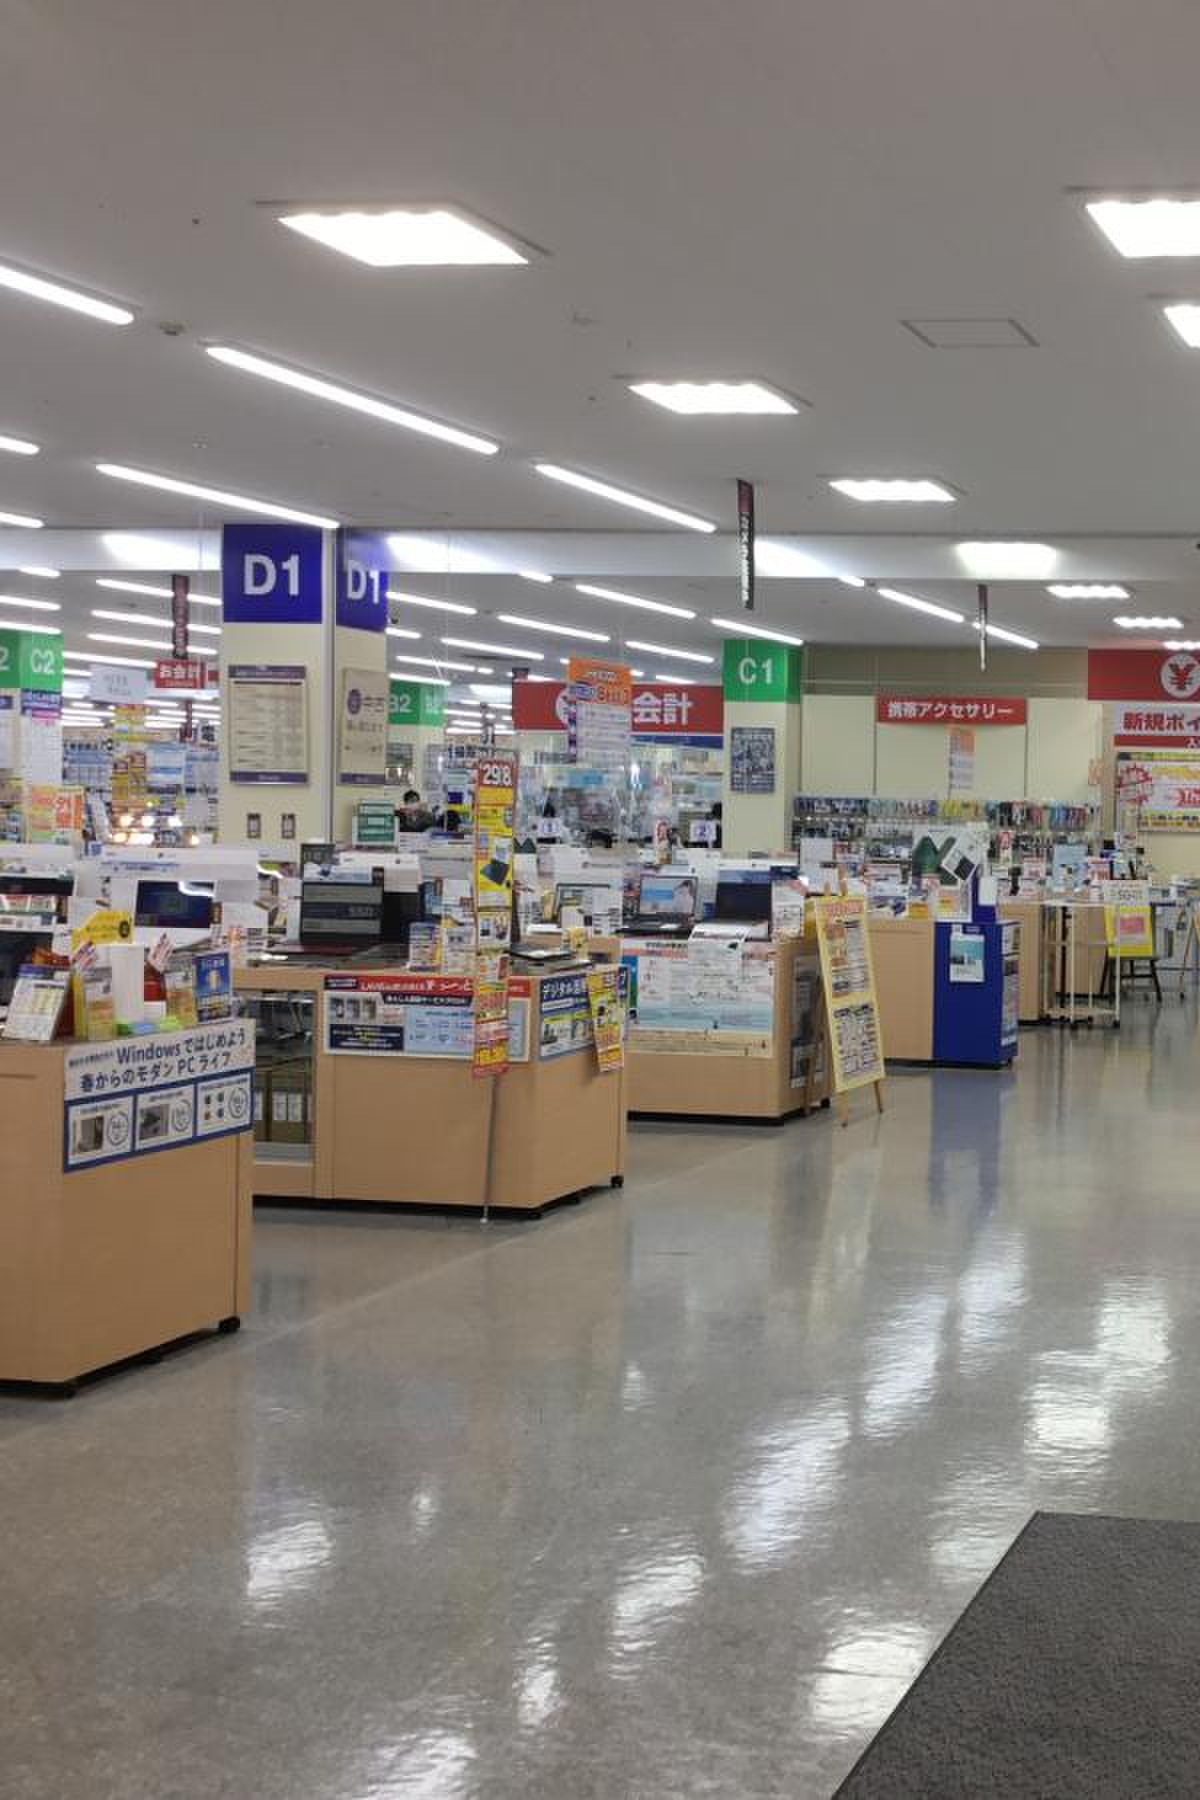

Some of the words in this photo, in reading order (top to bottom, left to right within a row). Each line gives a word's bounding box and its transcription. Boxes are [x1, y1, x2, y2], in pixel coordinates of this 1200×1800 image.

[243, 554, 300, 597] D1
[347, 560, 380, 604] D1
[30, 648, 56, 675] C2
[159, 663, 201, 679] お会計
[738, 657, 773, 685] C1
[632, 691, 693, 725] 会計
[887, 702, 1014, 720] 携帯アクセサリー
